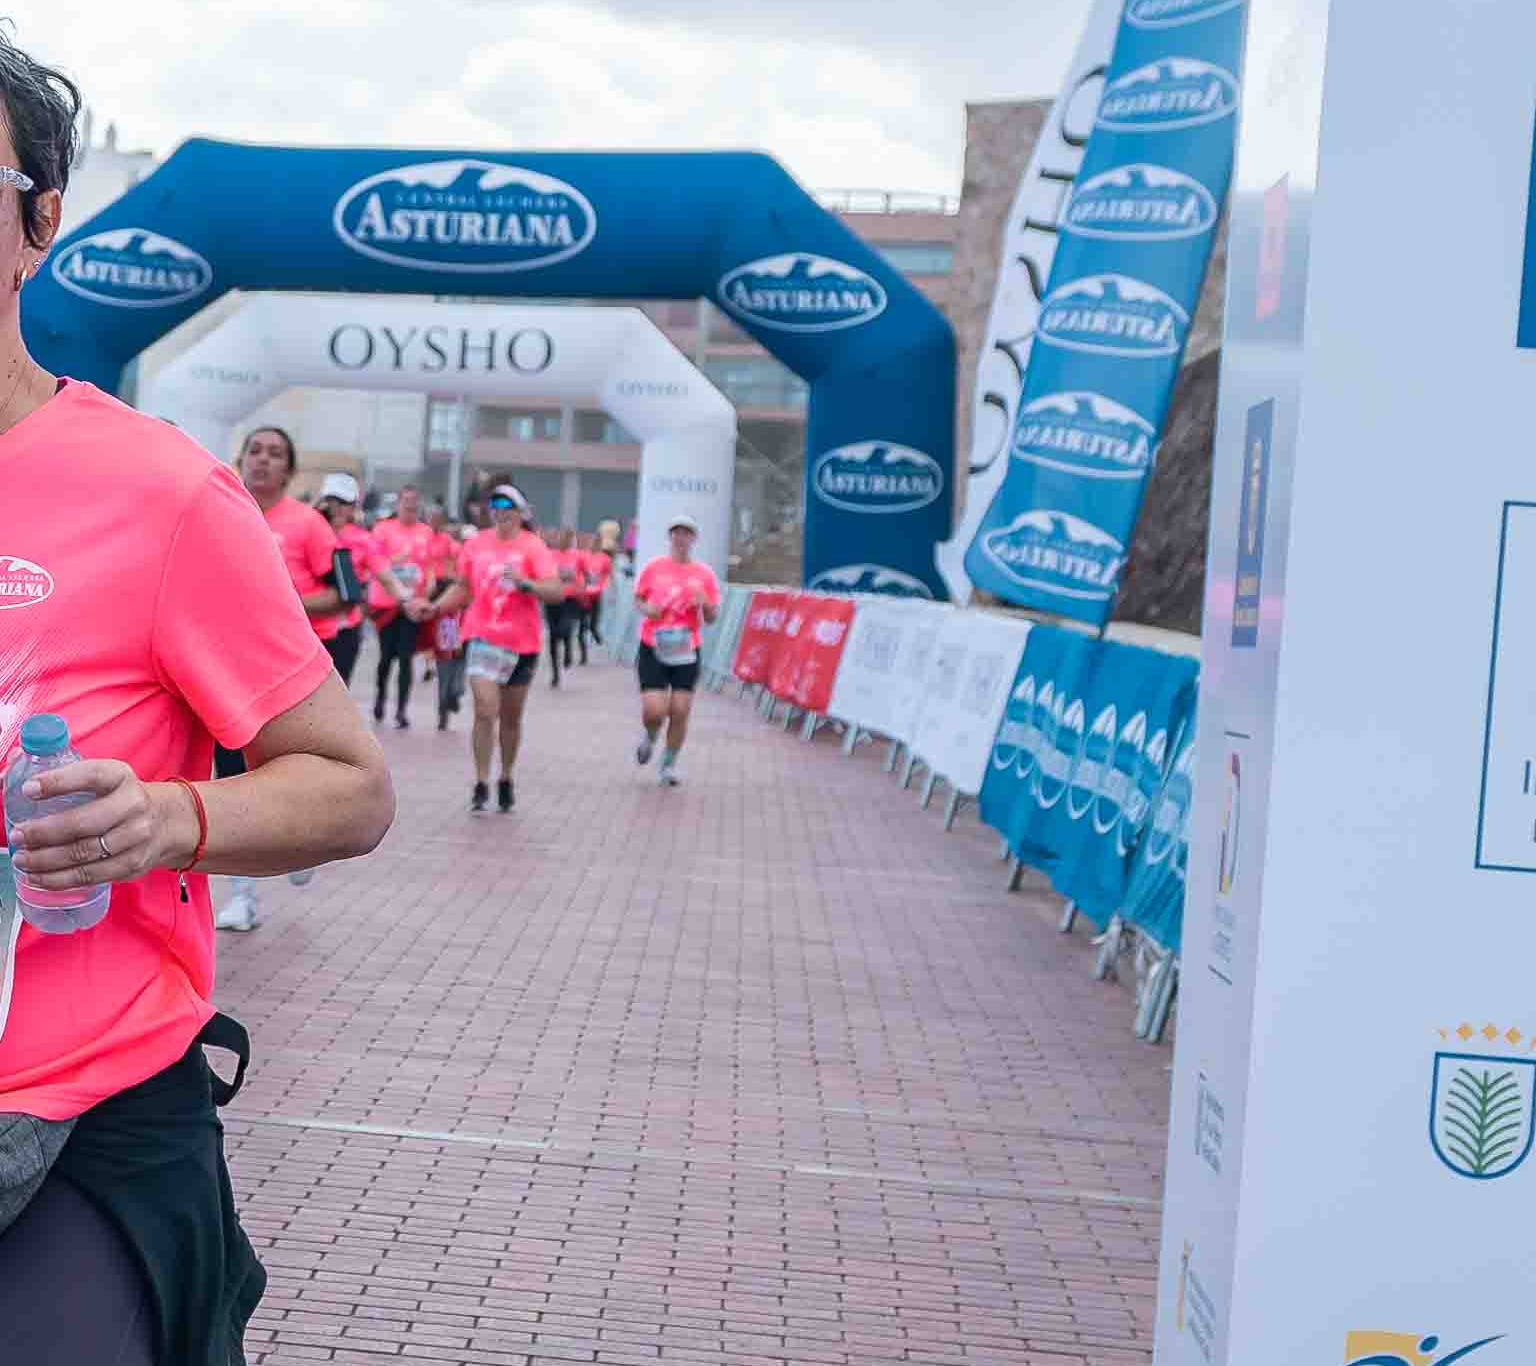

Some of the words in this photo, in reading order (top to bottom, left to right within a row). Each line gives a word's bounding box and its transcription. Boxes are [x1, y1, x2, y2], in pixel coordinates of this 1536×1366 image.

[355, 192, 577, 247] ASTURIANA
[60, 251, 199, 293] ASTURIANA
[731, 280, 875, 313] ASTURIANA
[327, 322, 556, 375] OYSHO
[820, 469, 935, 496] ASTURIANA
